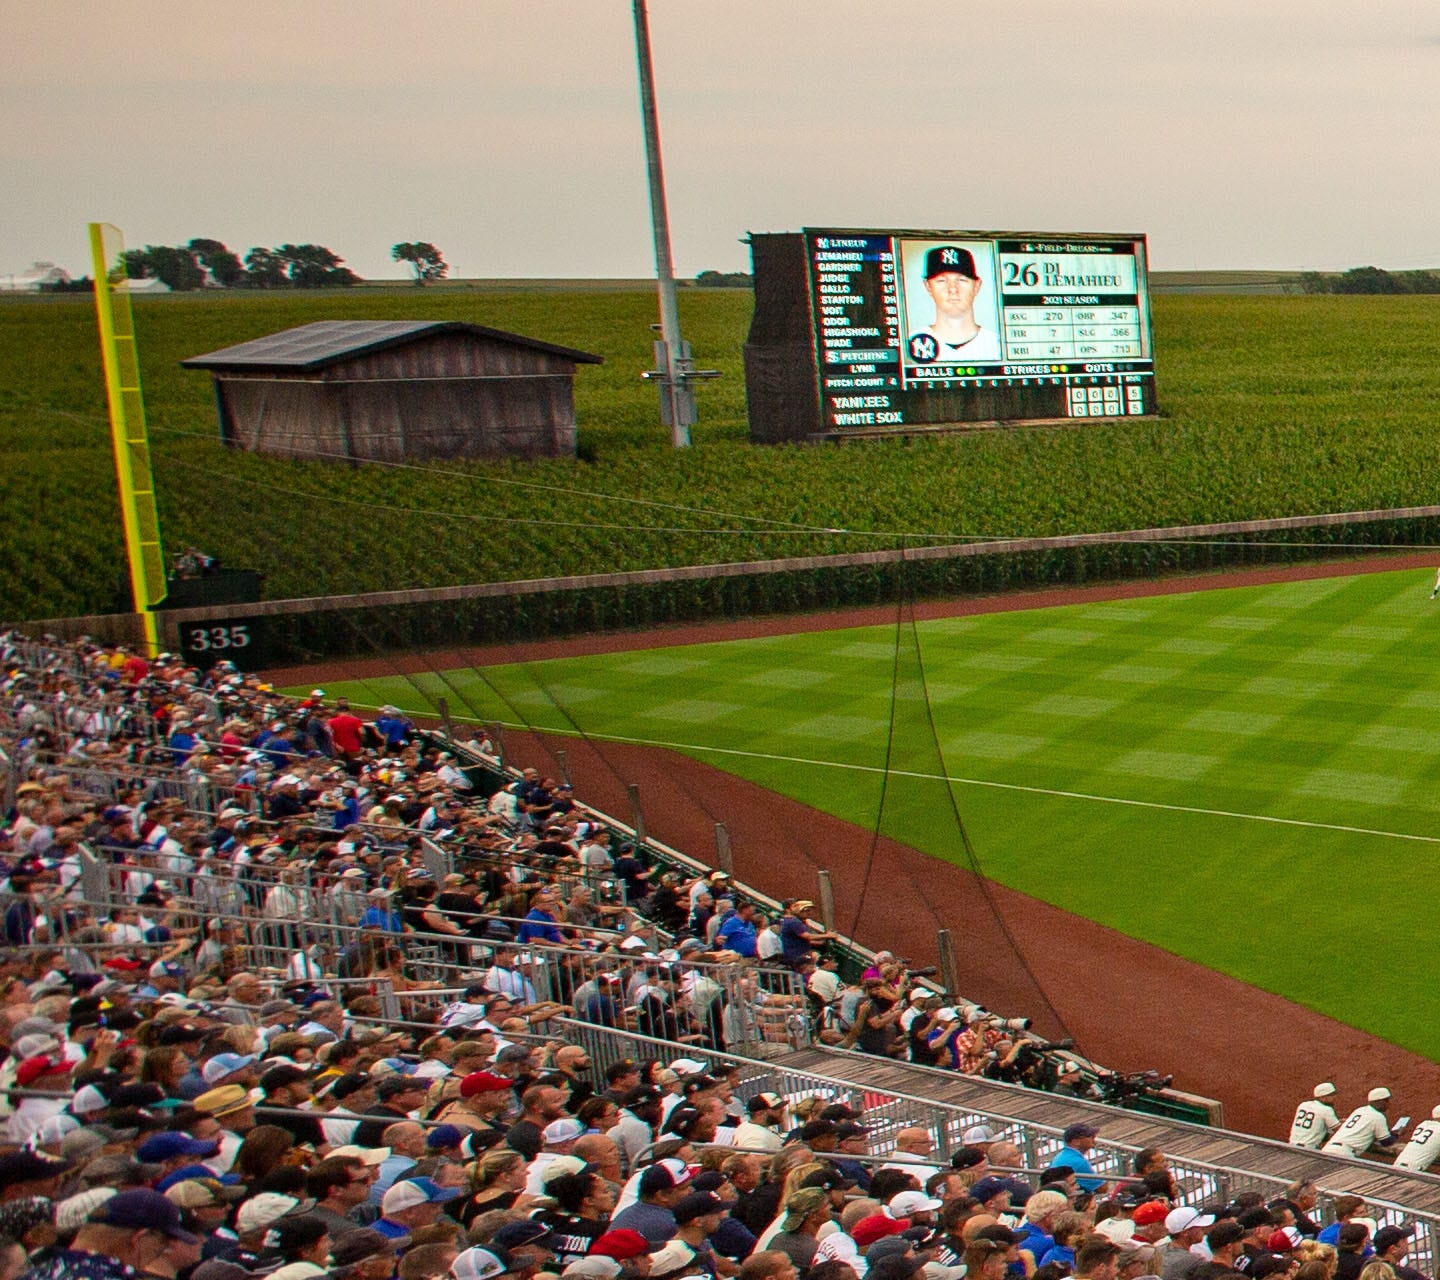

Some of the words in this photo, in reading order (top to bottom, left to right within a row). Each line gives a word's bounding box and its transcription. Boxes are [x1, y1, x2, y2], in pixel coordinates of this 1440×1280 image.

[820, 274, 850, 283] JUDGE
[1004, 262, 1039, 287] 26
[1046, 275, 1122, 287] LEMAHIEU
[820, 284, 851, 293] GALLO
[821, 295, 864, 304] STANTON
[914, 367, 954, 377] BALLS
[1003, 365, 1050, 375] STRIKES
[1085, 363, 1115, 372] OUTS
[832, 396, 890, 408] YANKEES
[833, 412, 875, 425] WHITE
[876, 411, 903, 423] SOX
[190, 625, 250, 651] 335
[1296, 1110, 1315, 1129] 28
[1411, 1127, 1433, 1145] 23
